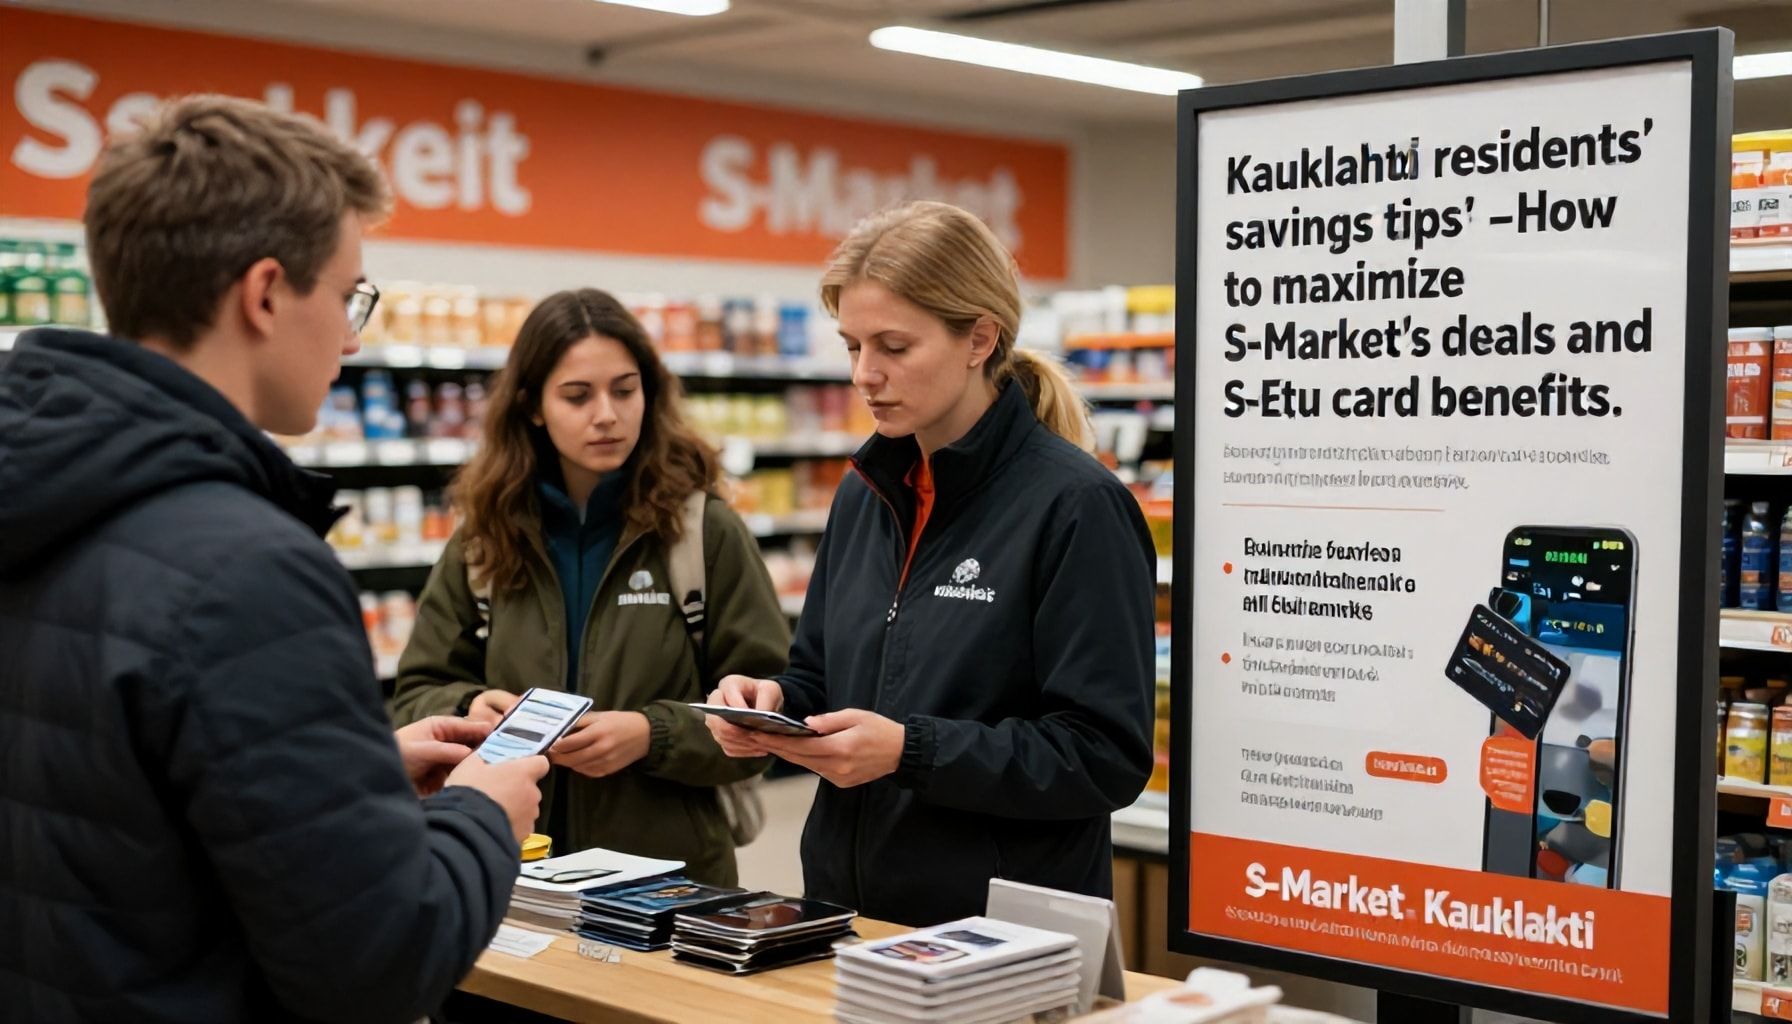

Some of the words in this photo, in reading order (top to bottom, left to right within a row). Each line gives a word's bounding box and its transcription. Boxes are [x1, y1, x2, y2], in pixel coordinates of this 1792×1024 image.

[1434, 117, 1655, 178] residents’
[1226, 206, 1374, 255] savings
[1224, 271, 1262, 307] to
[1273, 256, 1465, 305] maximize
[1224, 314, 1431, 362] S-Market’s
[1441, 311, 1556, 357] deals
[1566, 307, 1653, 354] and
[1223, 379, 1321, 419] S-Etu
[1332, 375, 1420, 419] card
[1431, 372, 1623, 418] benefits.
